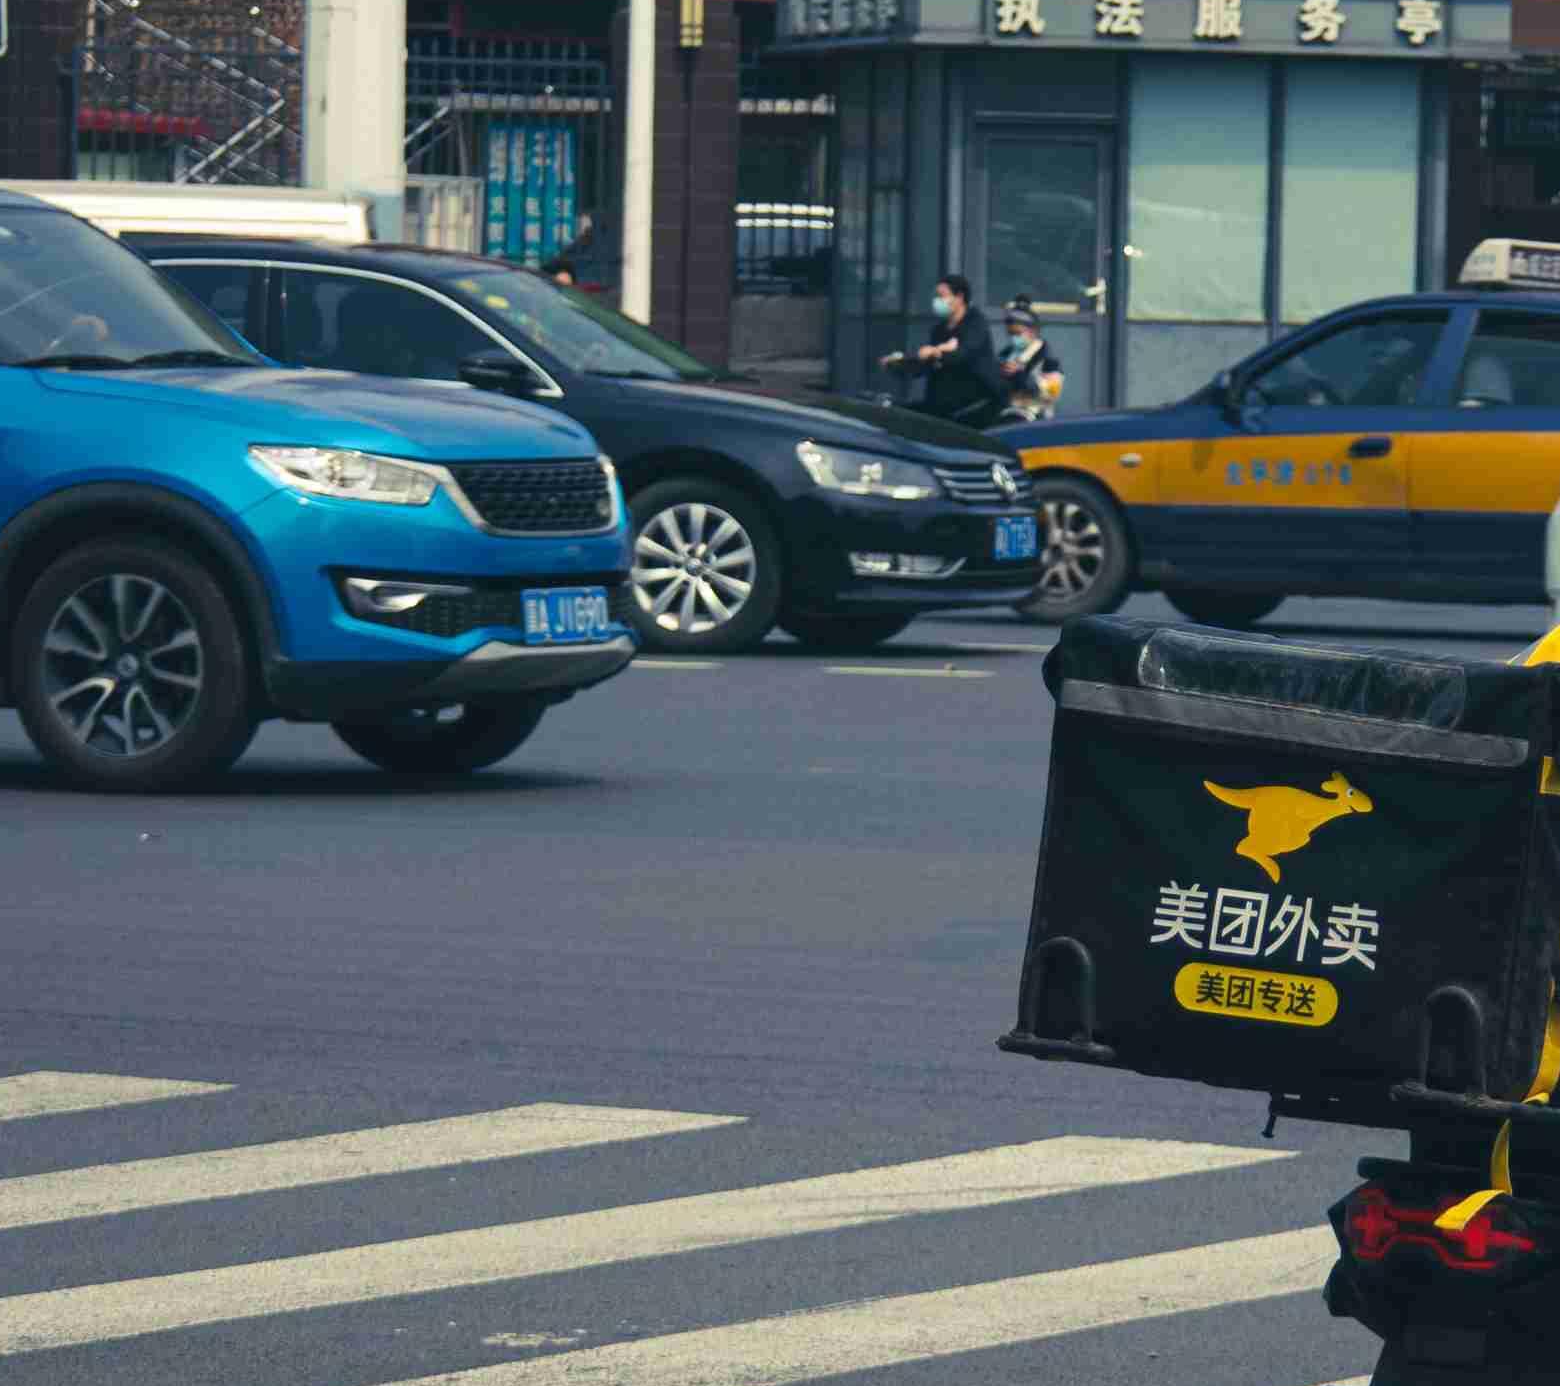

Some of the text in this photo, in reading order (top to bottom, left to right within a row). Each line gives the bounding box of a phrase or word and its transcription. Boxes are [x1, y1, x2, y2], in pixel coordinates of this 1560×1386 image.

[1150, 880, 1380, 972] 美团外卖
[1195, 970, 1316, 1018] 美团专送
